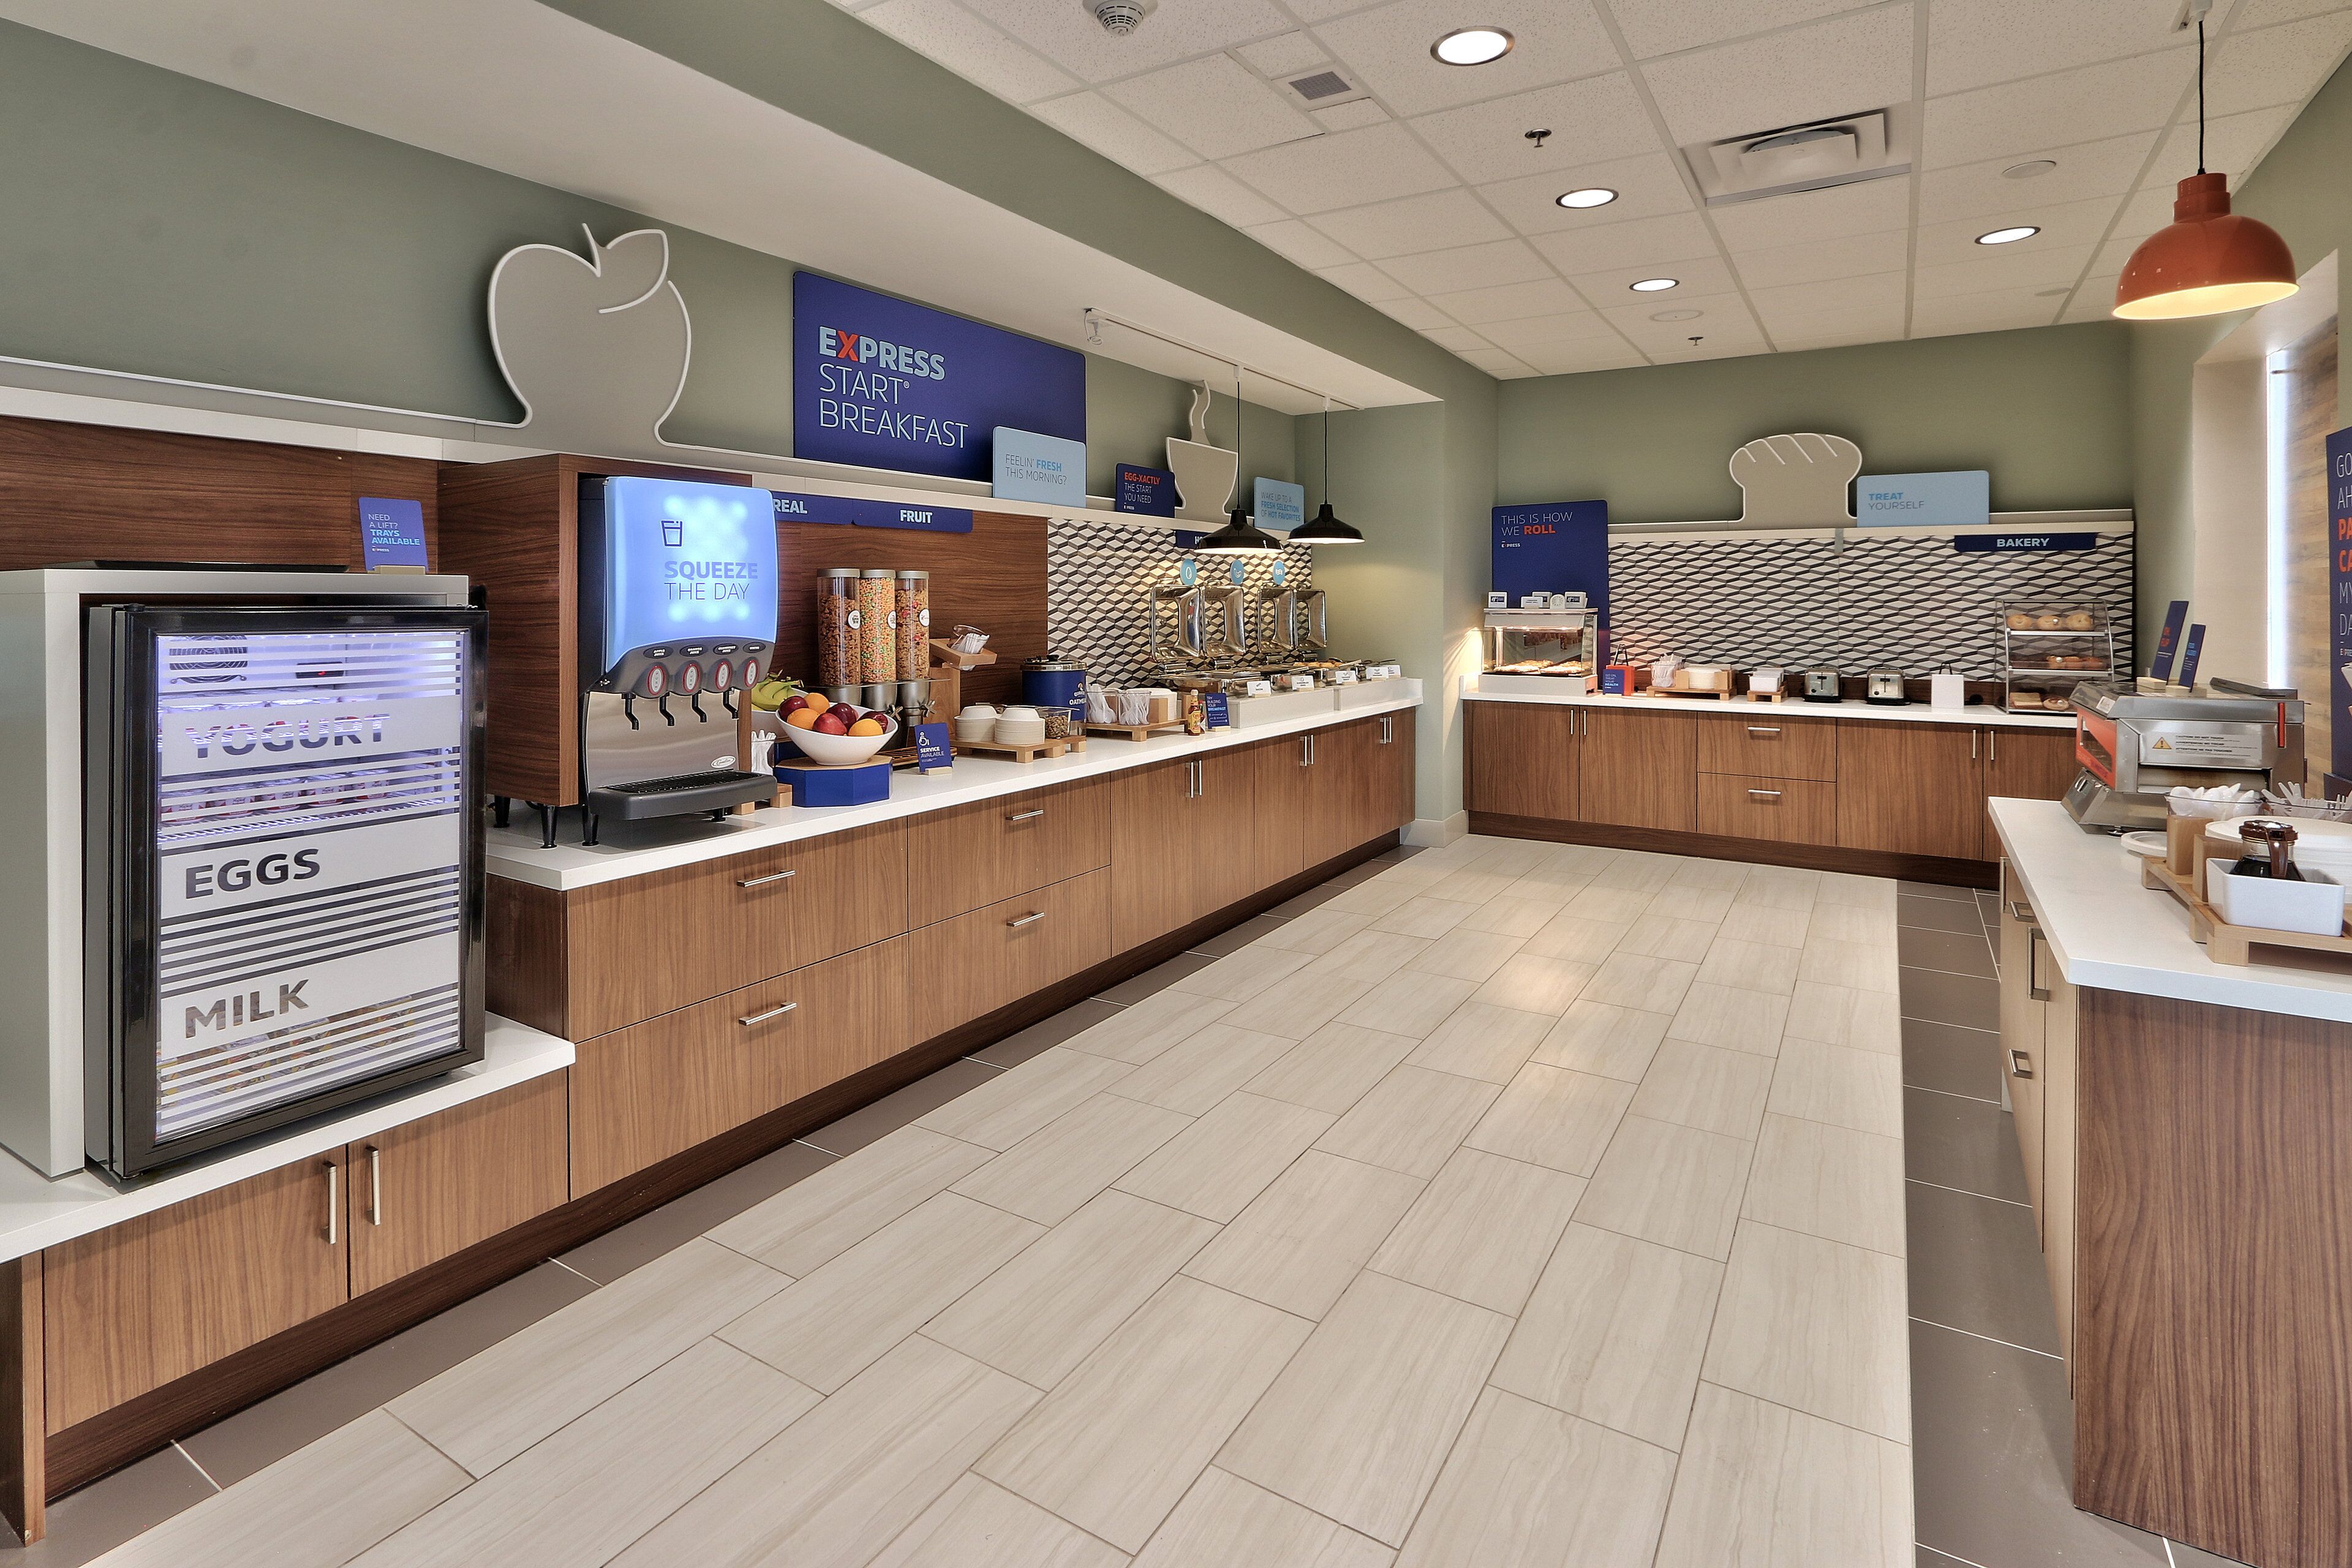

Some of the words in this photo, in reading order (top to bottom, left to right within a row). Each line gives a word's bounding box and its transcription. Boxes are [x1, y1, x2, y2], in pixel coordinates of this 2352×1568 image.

[818, 325, 946, 381] EXPRESS
[819, 398, 969, 448] BREAKFAST
[1036, 458, 1063, 472] FRESH
[1005, 466, 1024, 479] THIS
[1025, 469, 1067, 485] MORNING?
[1124, 471, 1161, 485] EGG-XACTLY
[1124, 482, 1136, 492] THE
[1136, 483, 1152, 494] START
[1124, 492, 1136, 502] YOU
[1137, 494, 1152, 503] NEED
[1868, 492, 1904, 500] TREAT
[1261, 500, 1276, 510] FRESH
[1276, 502, 1300, 513] SELECTION
[1868, 500, 1924, 510] YOURSELF
[899, 509, 933, 524] FRUIT
[1268, 510, 1278, 519] HOT
[1278, 511, 1301, 522] FAVORITES
[1501, 514, 1526, 525] THIS
[1529, 513, 1539, 524] IS
[1543, 511, 1573, 522] HOW
[1501, 526, 1520, 536] WE
[1523, 524, 1556, 535] ROLL
[371, 537, 421, 546] AVAILABLE
[1997, 538, 2050, 547] BAKERY
[664, 560, 758, 580] SQUEEZE
[664, 582, 706, 600] THE
[714, 582, 750, 600] DAY
[185, 713, 391, 759] YOGURT
[186, 848, 321, 899] EGGS
[185, 979, 309, 1039] MILK
